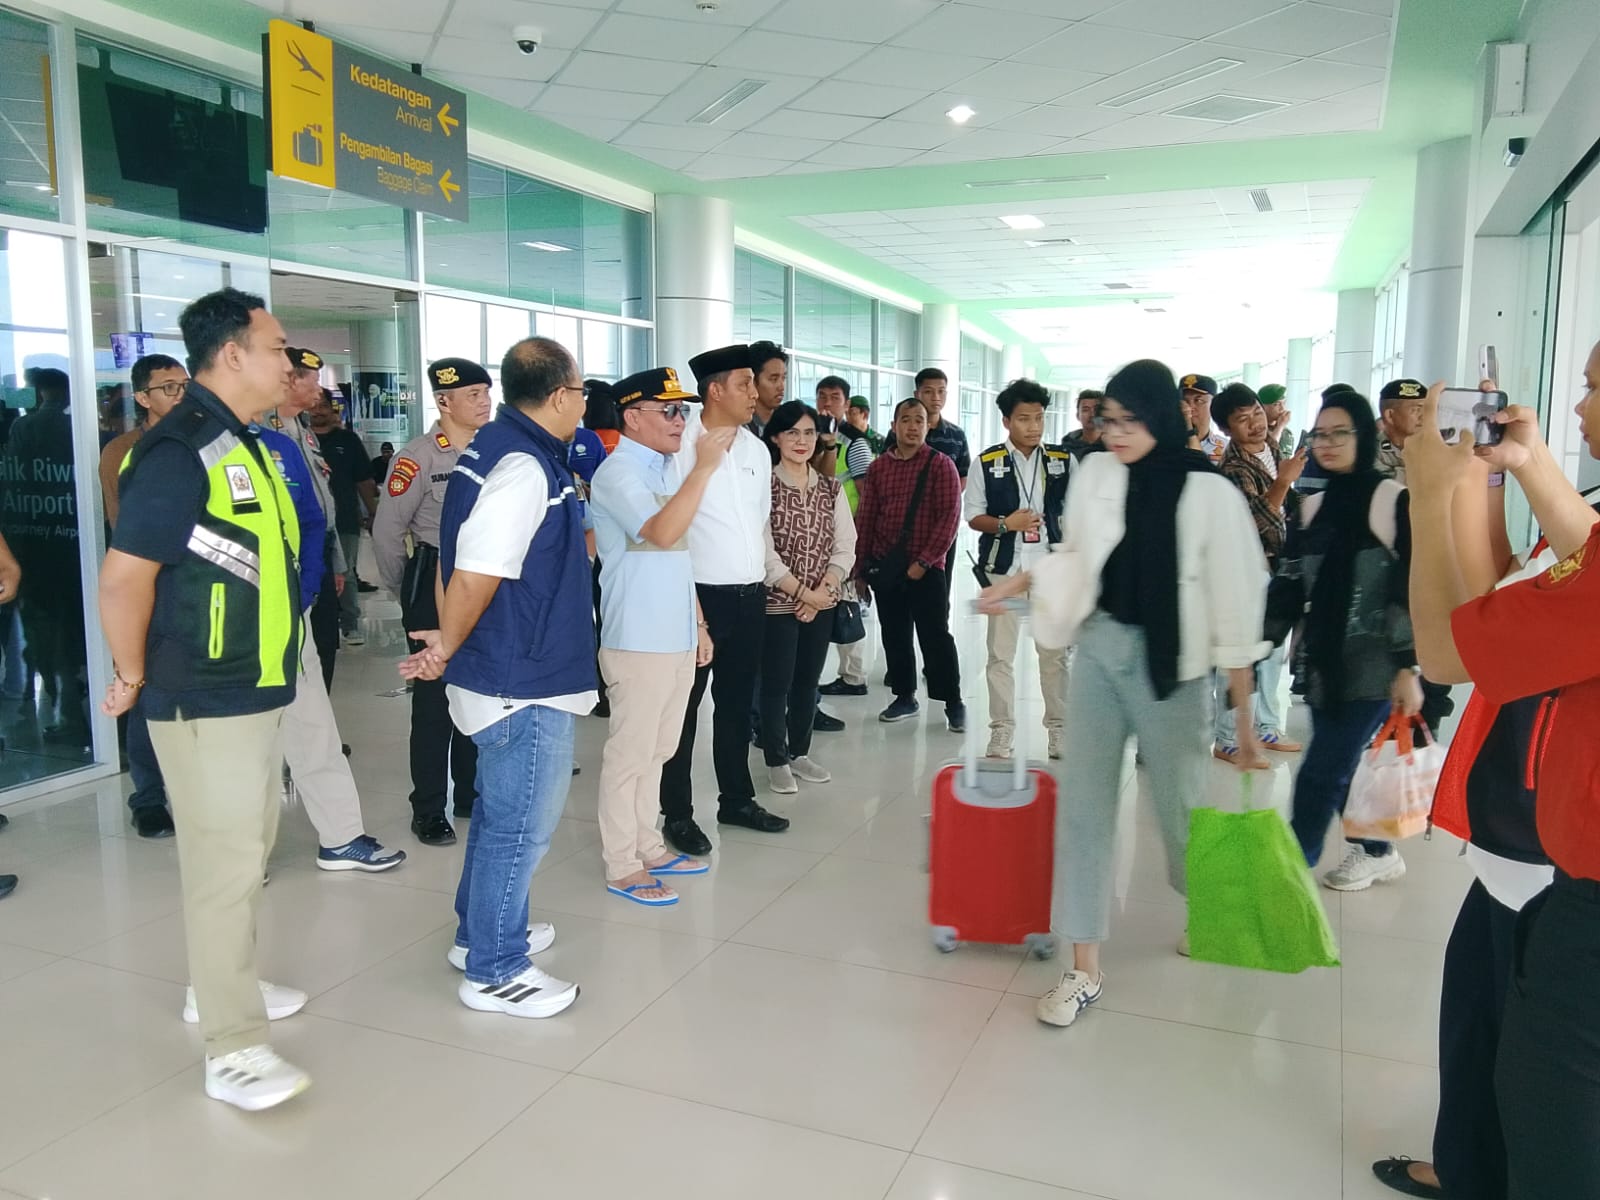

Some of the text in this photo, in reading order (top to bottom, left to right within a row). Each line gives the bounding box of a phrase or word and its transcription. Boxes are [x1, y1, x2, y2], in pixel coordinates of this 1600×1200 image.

[350, 64, 432, 109] Kedatangan
[396, 106, 432, 132] Arrival
[340, 132, 433, 176] Pengambilan Bagasi
[377, 166, 412, 193] Baggage
[32, 457, 74, 482] Riw
[3, 489, 74, 520] Airport
[54, 525, 80, 540] Airp
